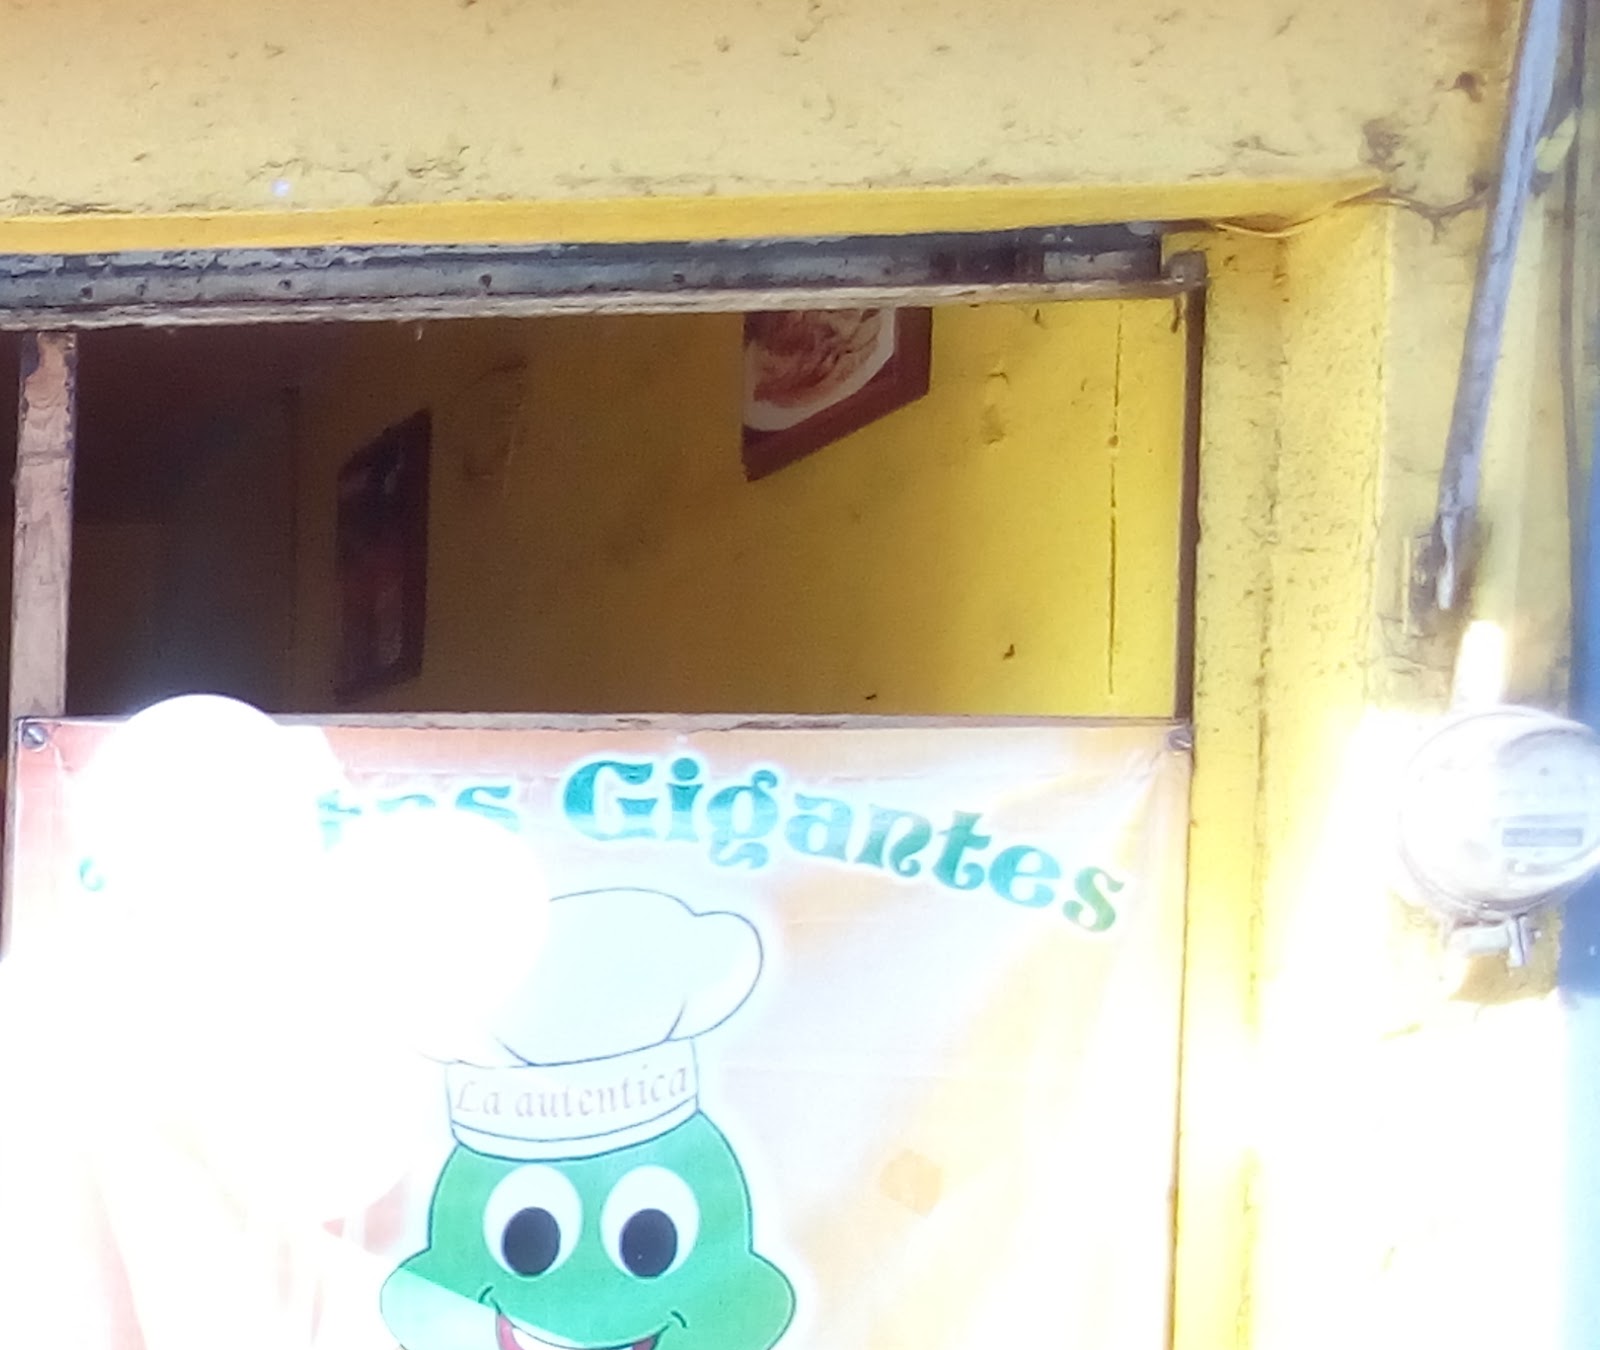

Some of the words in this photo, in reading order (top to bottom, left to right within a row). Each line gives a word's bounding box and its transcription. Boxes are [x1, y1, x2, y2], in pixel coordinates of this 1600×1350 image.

[562, 756, 1125, 933] Gigantes
[454, 1080, 502, 1116] La
[514, 1063, 688, 1118] autentica
